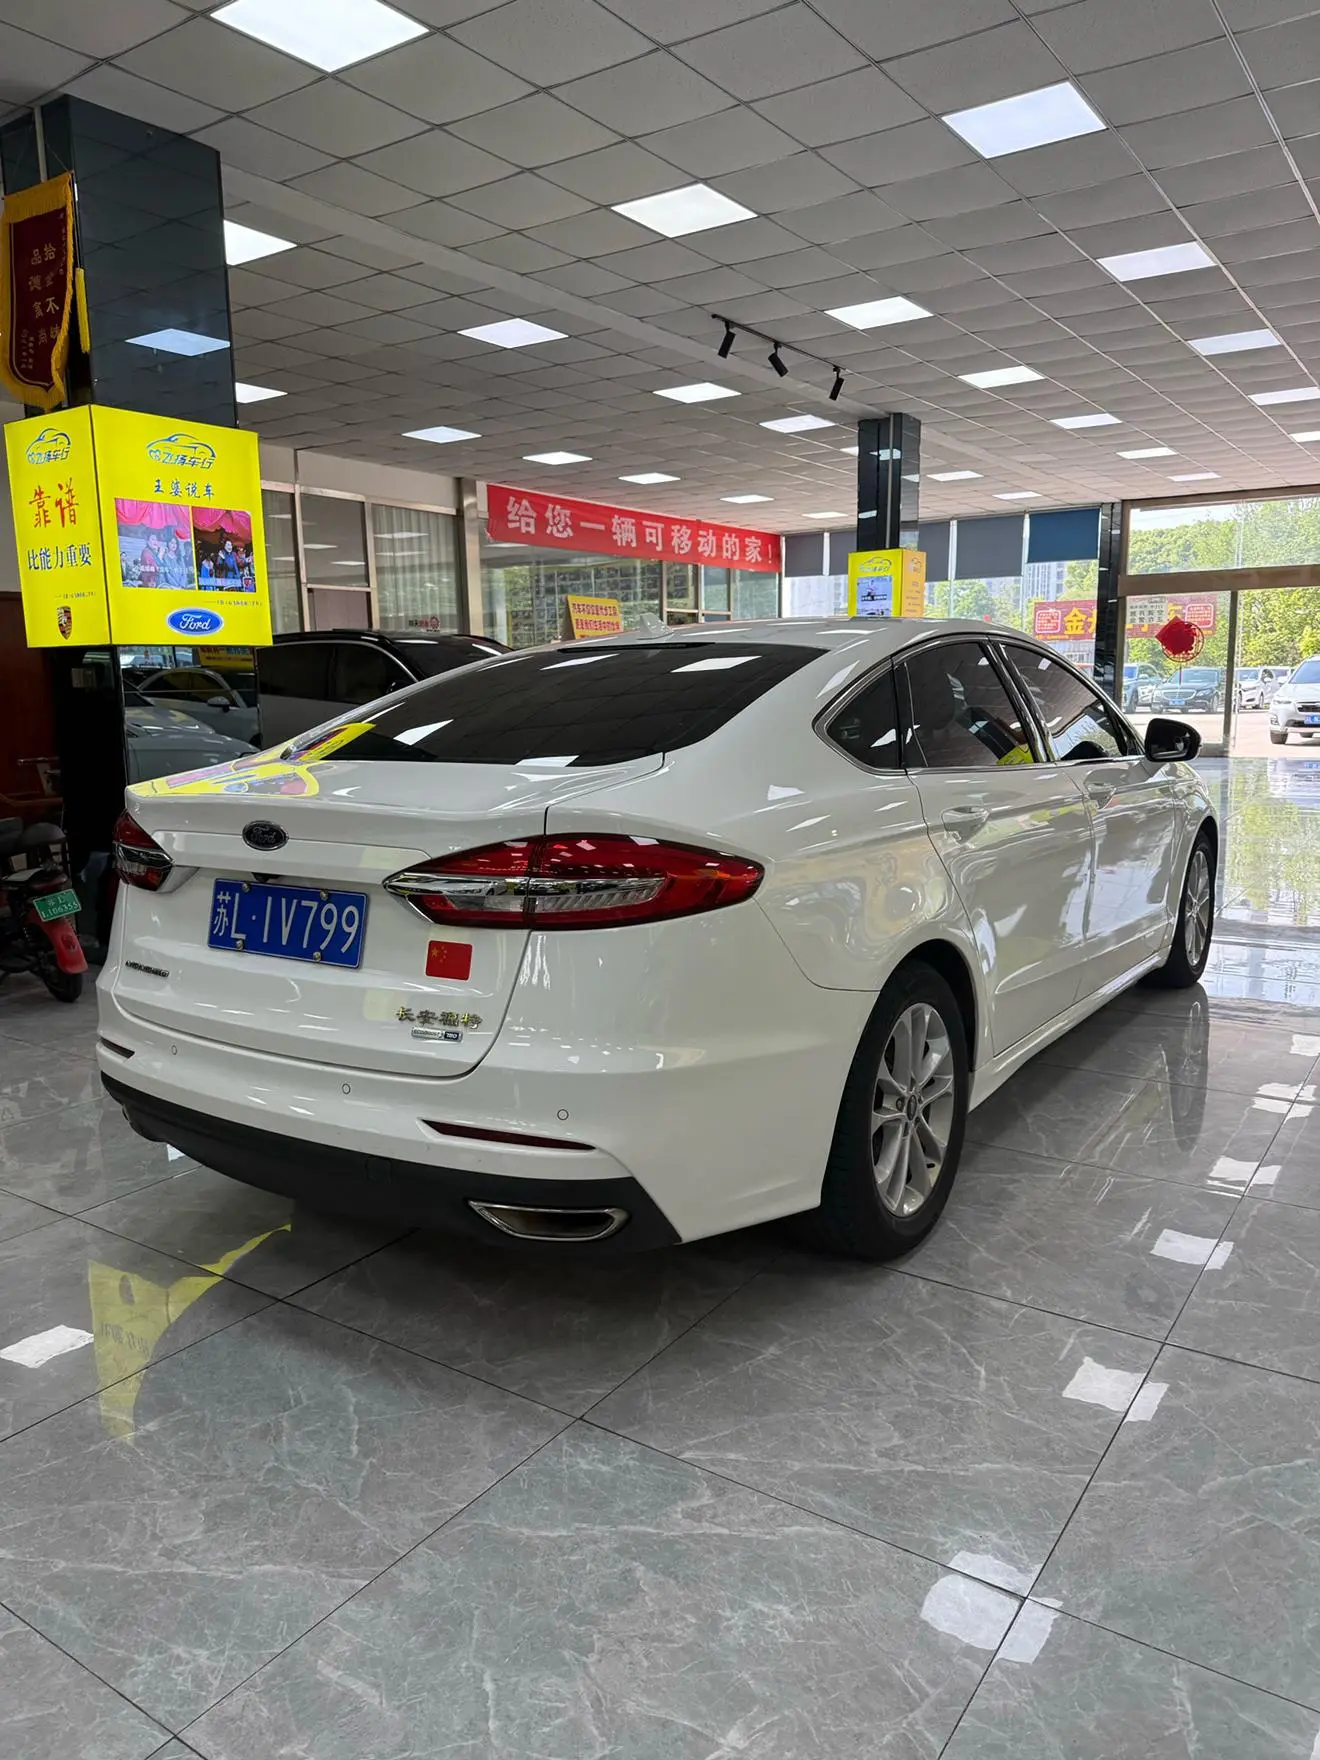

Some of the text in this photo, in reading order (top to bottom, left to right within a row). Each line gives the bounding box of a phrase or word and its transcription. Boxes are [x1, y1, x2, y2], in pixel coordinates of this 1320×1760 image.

[29, 477, 79, 528] 靠谱
[506, 496, 773, 565] 给您一辆可移动的家！
[27, 542, 92, 571] 比能力重要
[180, 613, 211, 631] Ford
